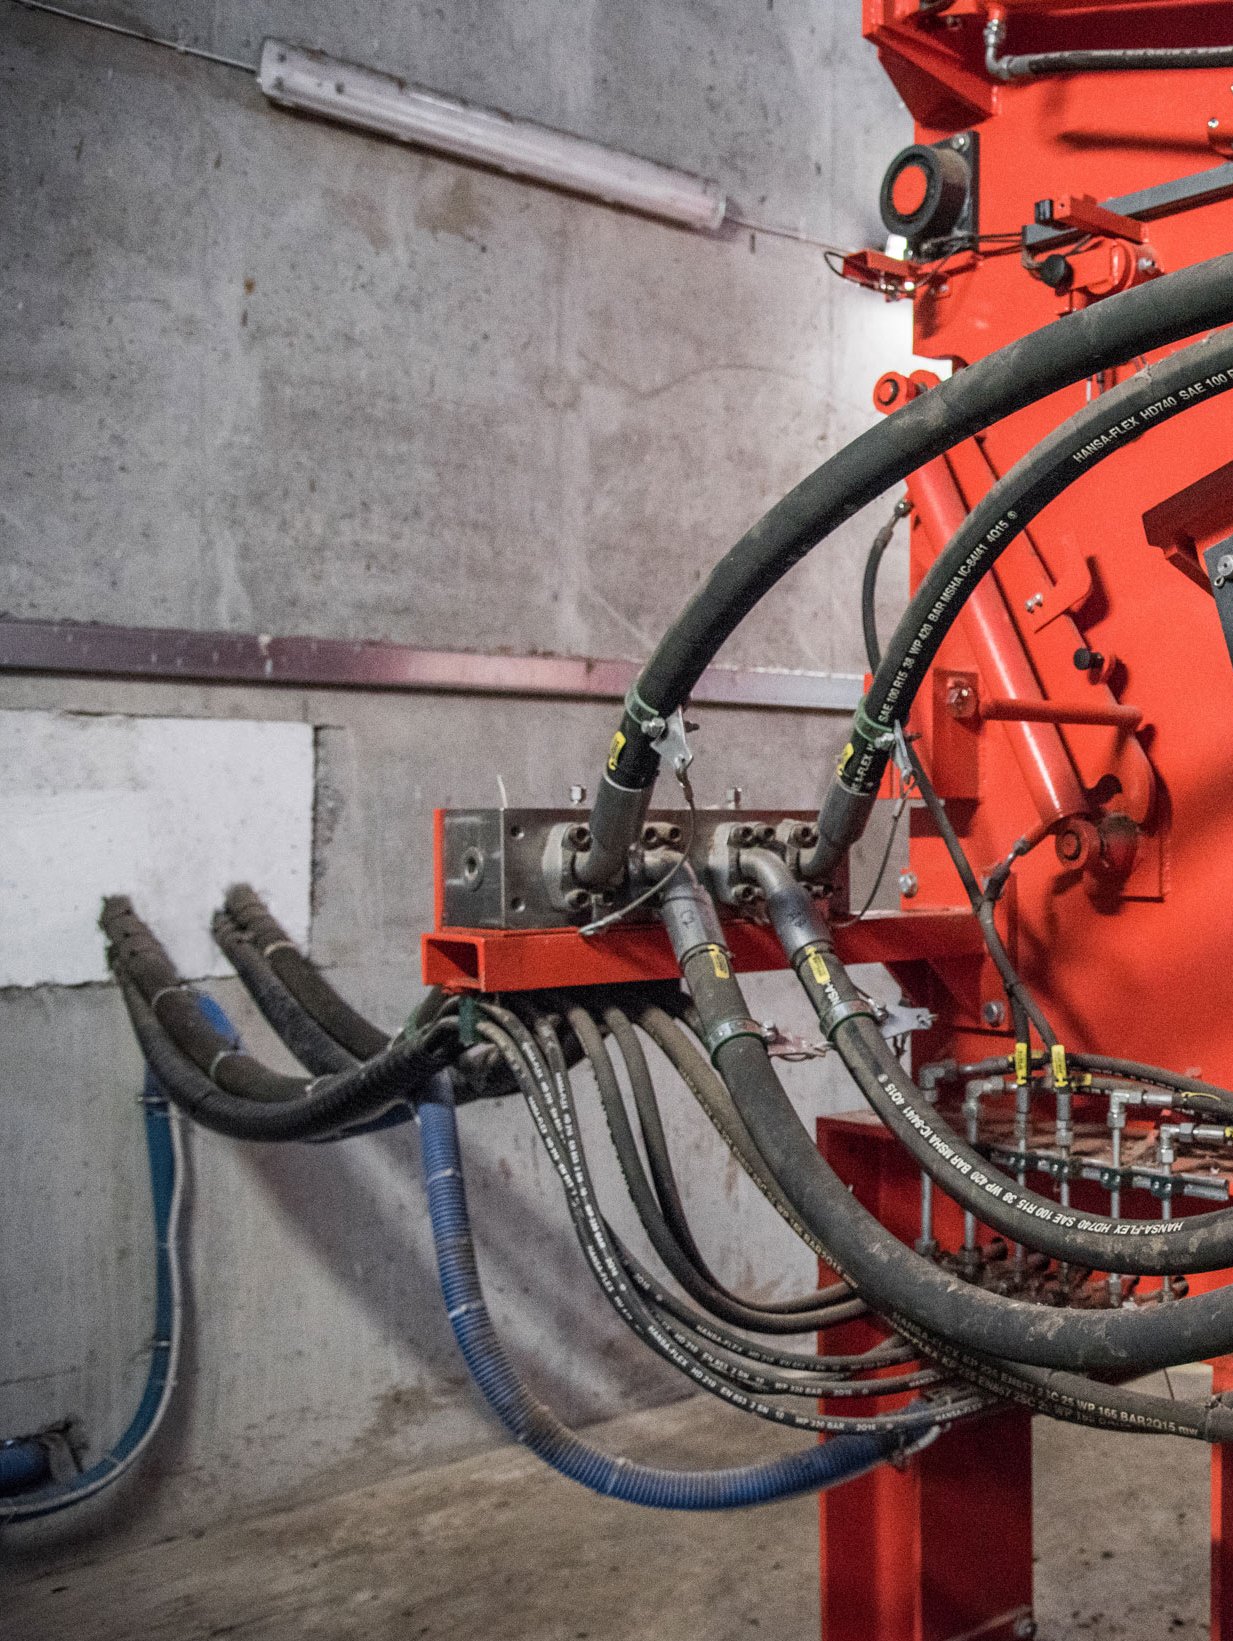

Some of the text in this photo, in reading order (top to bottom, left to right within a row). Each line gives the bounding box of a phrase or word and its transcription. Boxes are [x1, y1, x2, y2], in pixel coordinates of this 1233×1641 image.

[1073, 416, 1140, 464] HANSA-FLEX
[1140, 396, 1178, 422] HD740
[1179, 382, 1206, 401] SAE
[1205, 373, 1228, 390] 100
[940, 576, 964, 605] MSHA
[928, 595, 947, 623] BAR
[917, 623, 934, 644] 420
[908, 636, 924, 655] WP
[903, 656, 916, 670] 38
[893, 670, 909, 690] R15
[886, 684, 901, 705] 100
[877, 703, 892, 724] SAE
[930, 1133, 954, 1159] MSHA
[949, 1151, 972, 1174] BAR
[969, 1169, 988, 1188] 420
[985, 1179, 1005, 1198] WP
[1001, 1191, 1017, 1204] 38
[1016, 1197, 1037, 1215] R15
[1035, 1206, 1055, 1223] 100
[1052, 1211, 1077, 1229] SAE
[1076, 1217, 1112, 1233] HD740
[1114, 1219, 1186, 1236] HANSA-FLEX
[1076, 1399, 1096, 1412] WP
[1098, 1406, 1119, 1420] 165
[1119, 1411, 1177, 1432] BAR2Q15
